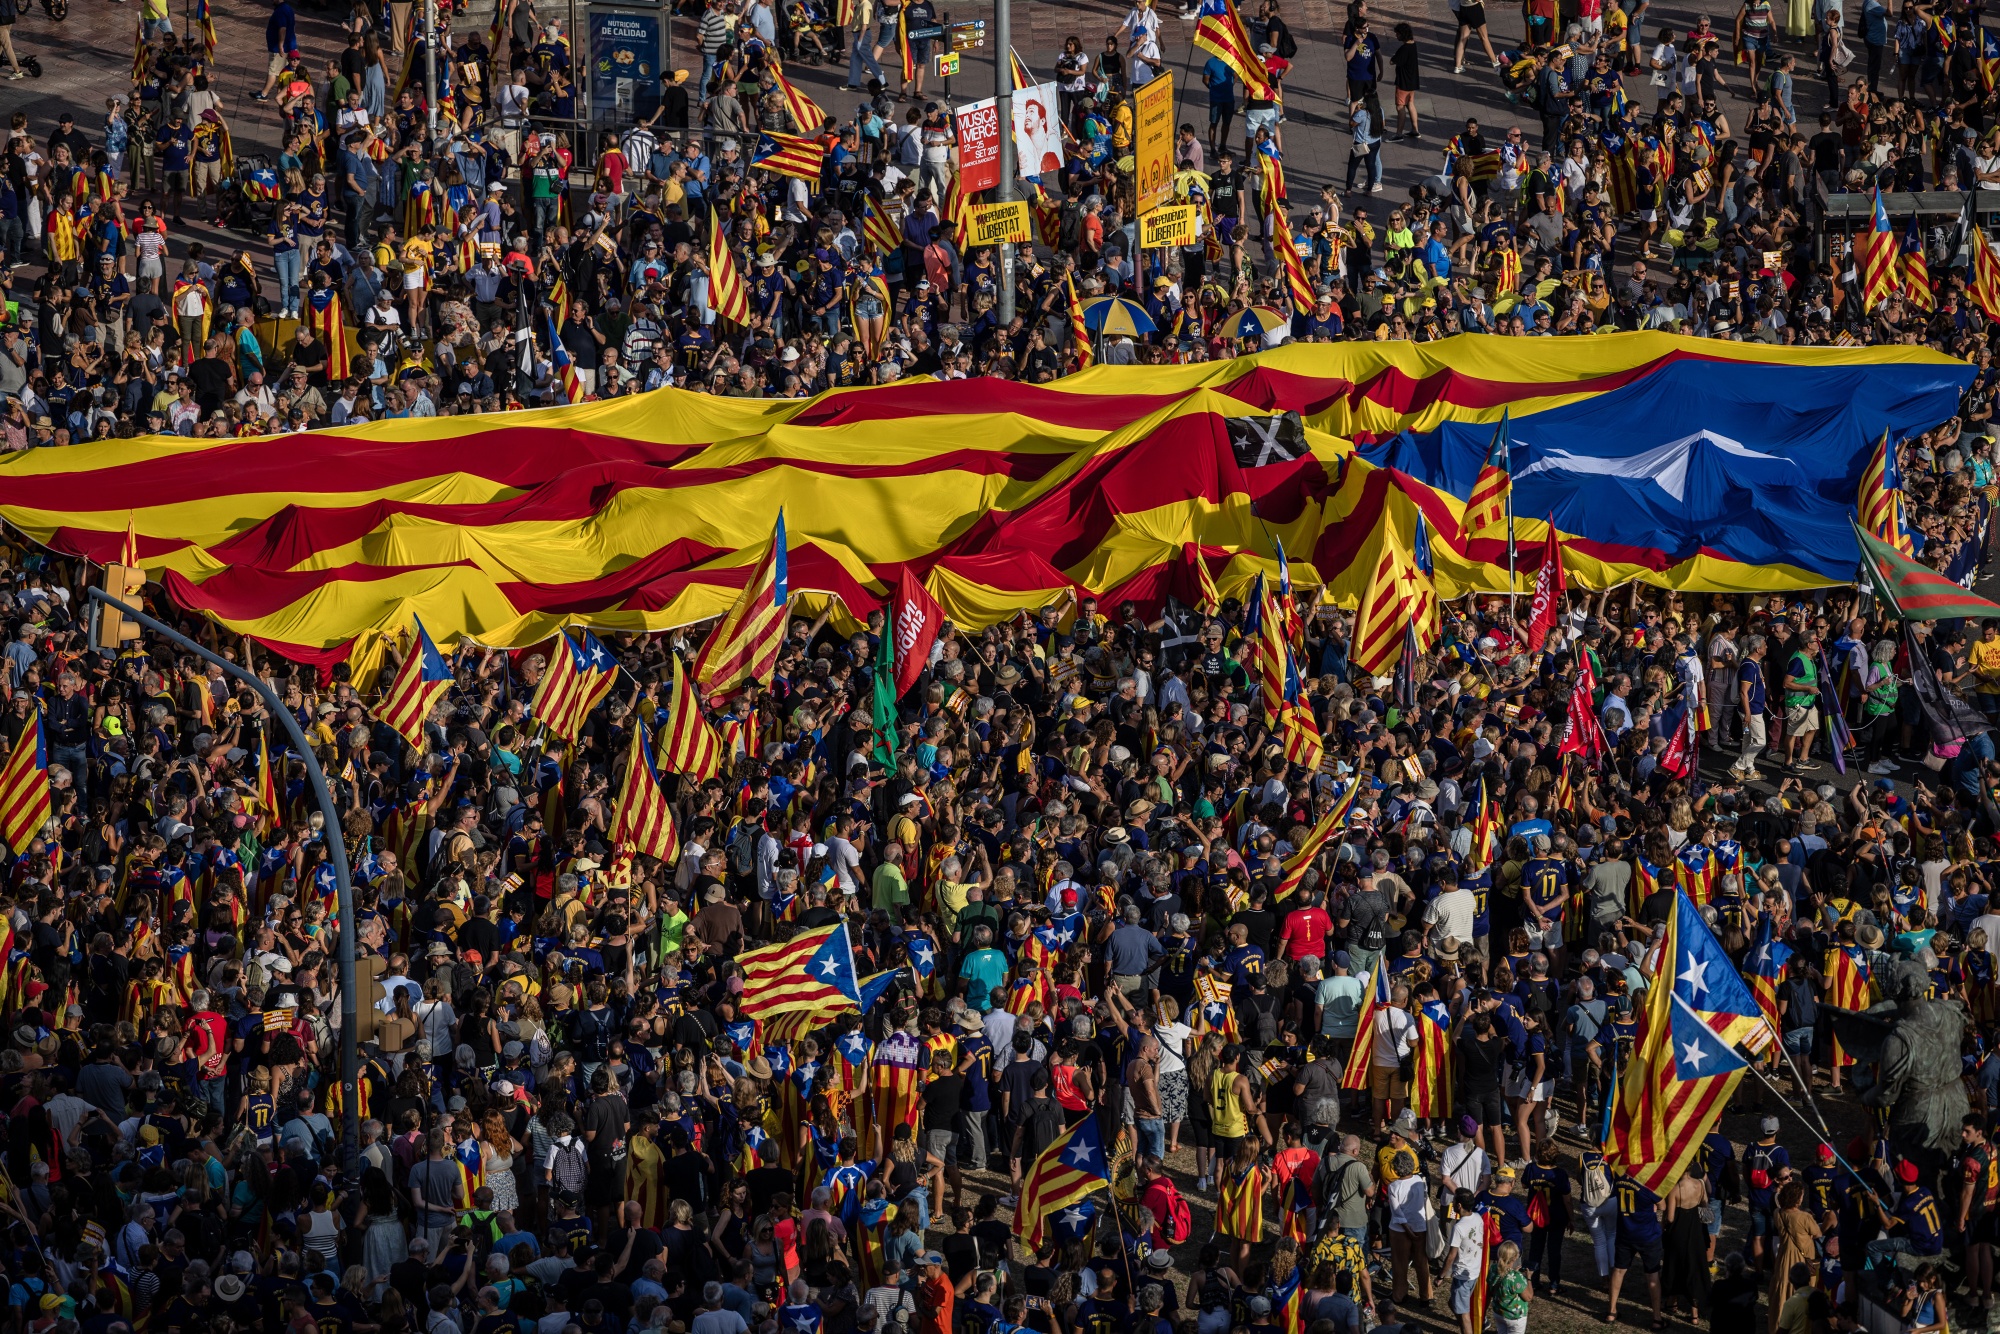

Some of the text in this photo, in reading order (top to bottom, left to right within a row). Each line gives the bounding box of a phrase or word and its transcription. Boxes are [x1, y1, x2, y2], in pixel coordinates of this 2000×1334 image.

[602, 26, 646, 38] DE CALIDAD
[608, 20, 640, 28] NUTRICIÓN
[950, 62, 958, 72] L3
[958, 108, 997, 130] MÚSICA
[963, 120, 998, 143] MERCÈ
[975, 148, 987, 159] SET
[978, 217, 1020, 241] LLIBERTAT
[1147, 220, 1188, 244] LLIBERTAT
[1542, 874, 1556, 897] 11
[1245, 960, 1260, 973] 11
[1216, 1088, 1226, 1110] 5
[255, 1108, 268, 1127] 11
[1988, 1160, 1998, 1189] 8
[1618, 1188, 1635, 1213] 11
[1919, 1202, 1941, 1234] 11
[570, 1235, 587, 1252] 11
